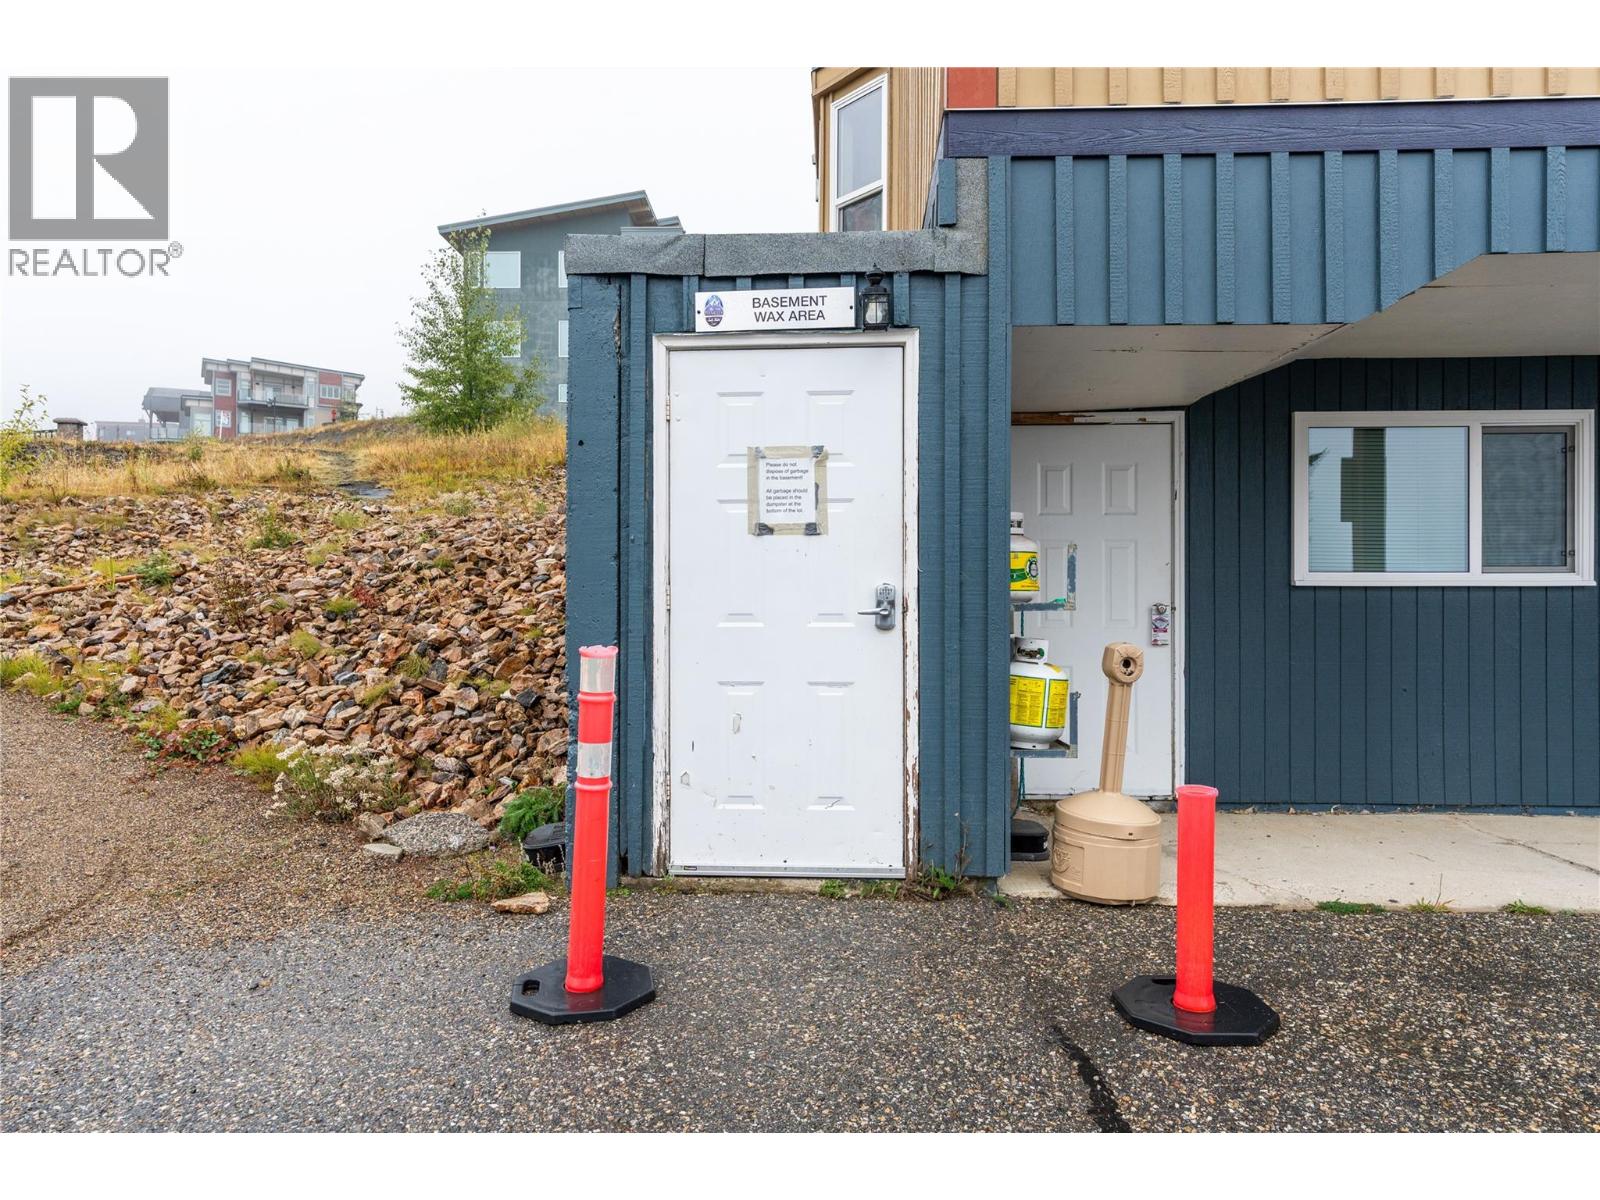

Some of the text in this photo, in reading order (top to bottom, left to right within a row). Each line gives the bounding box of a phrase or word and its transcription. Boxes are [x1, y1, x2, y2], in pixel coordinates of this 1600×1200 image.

[752, 295, 828, 309] BASEMENT
[754, 310, 826, 323] WAX AREA
